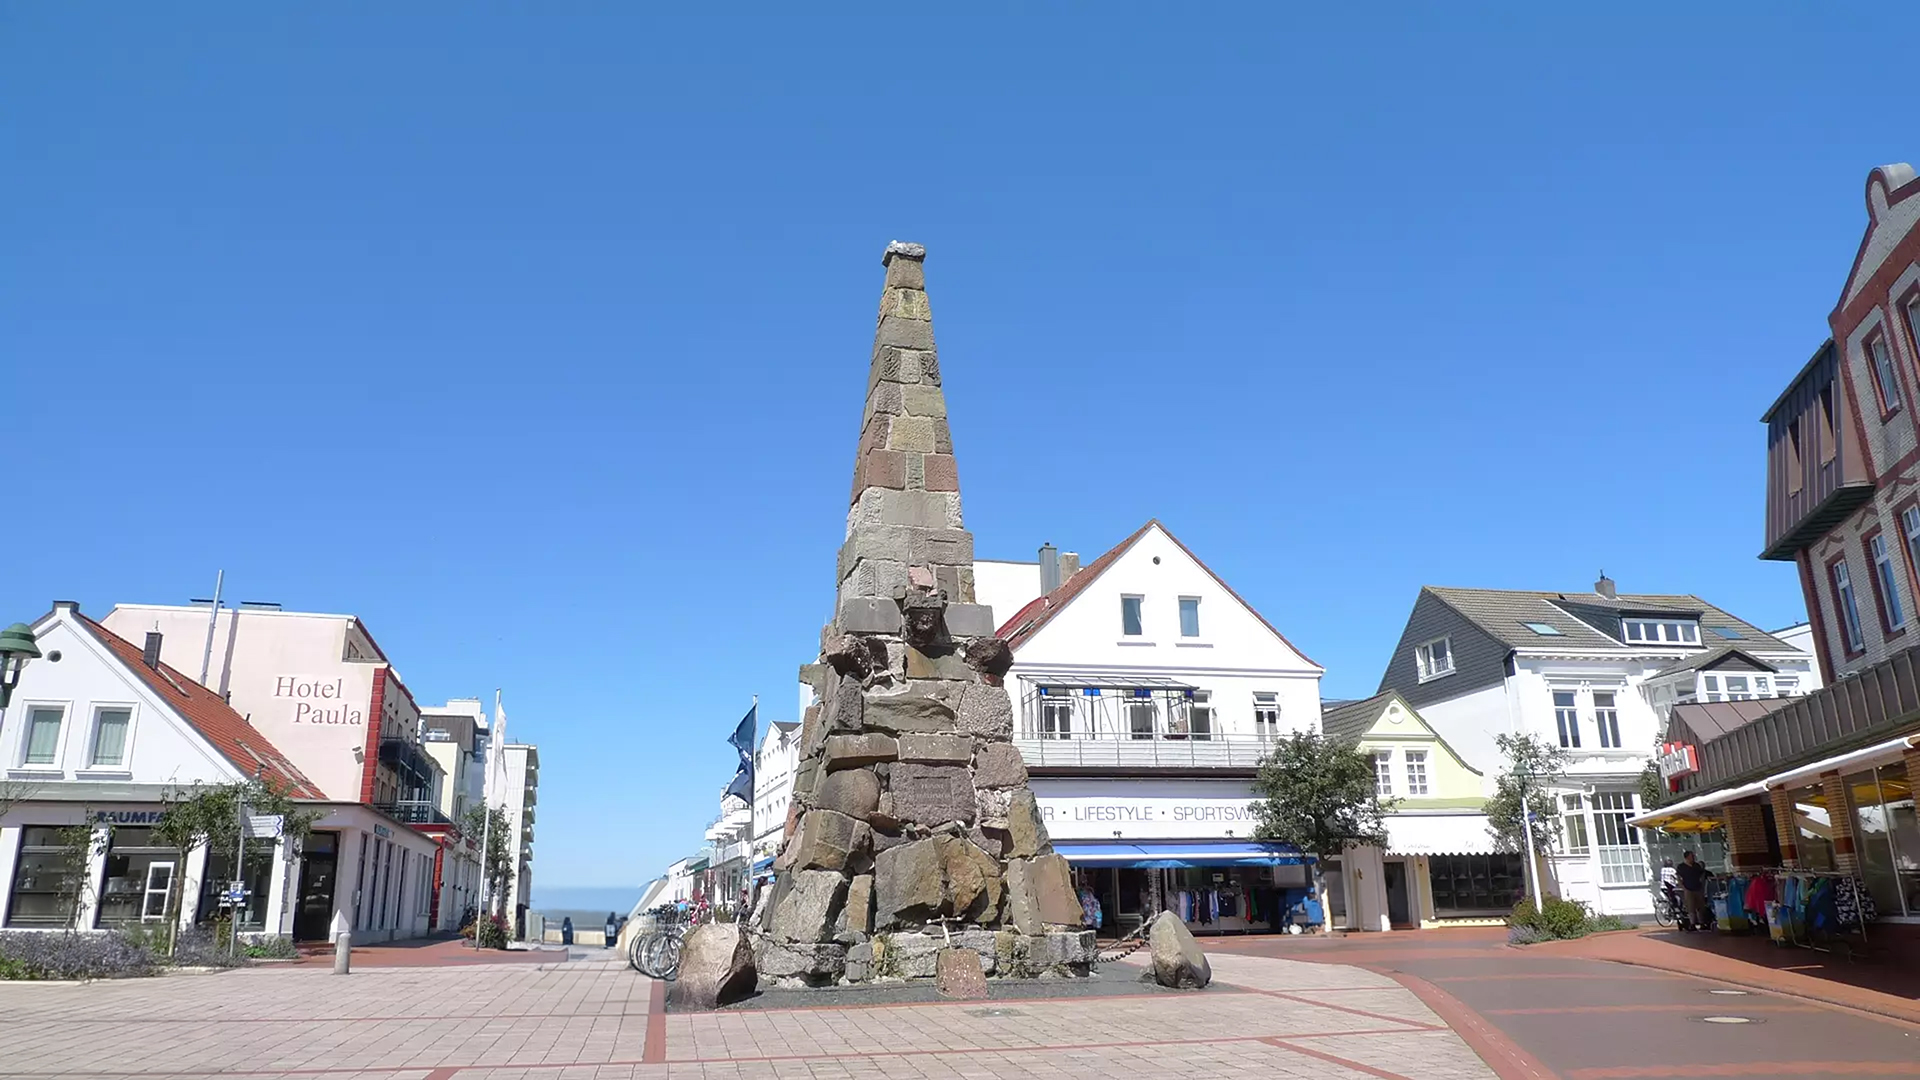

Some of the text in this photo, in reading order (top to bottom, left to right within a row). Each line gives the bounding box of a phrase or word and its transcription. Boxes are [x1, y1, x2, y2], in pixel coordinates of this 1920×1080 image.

[273, 676, 343, 699] Hotel
[293, 702, 363, 725] Paula
[1074, 806, 1153, 821] LIFESTYLE
